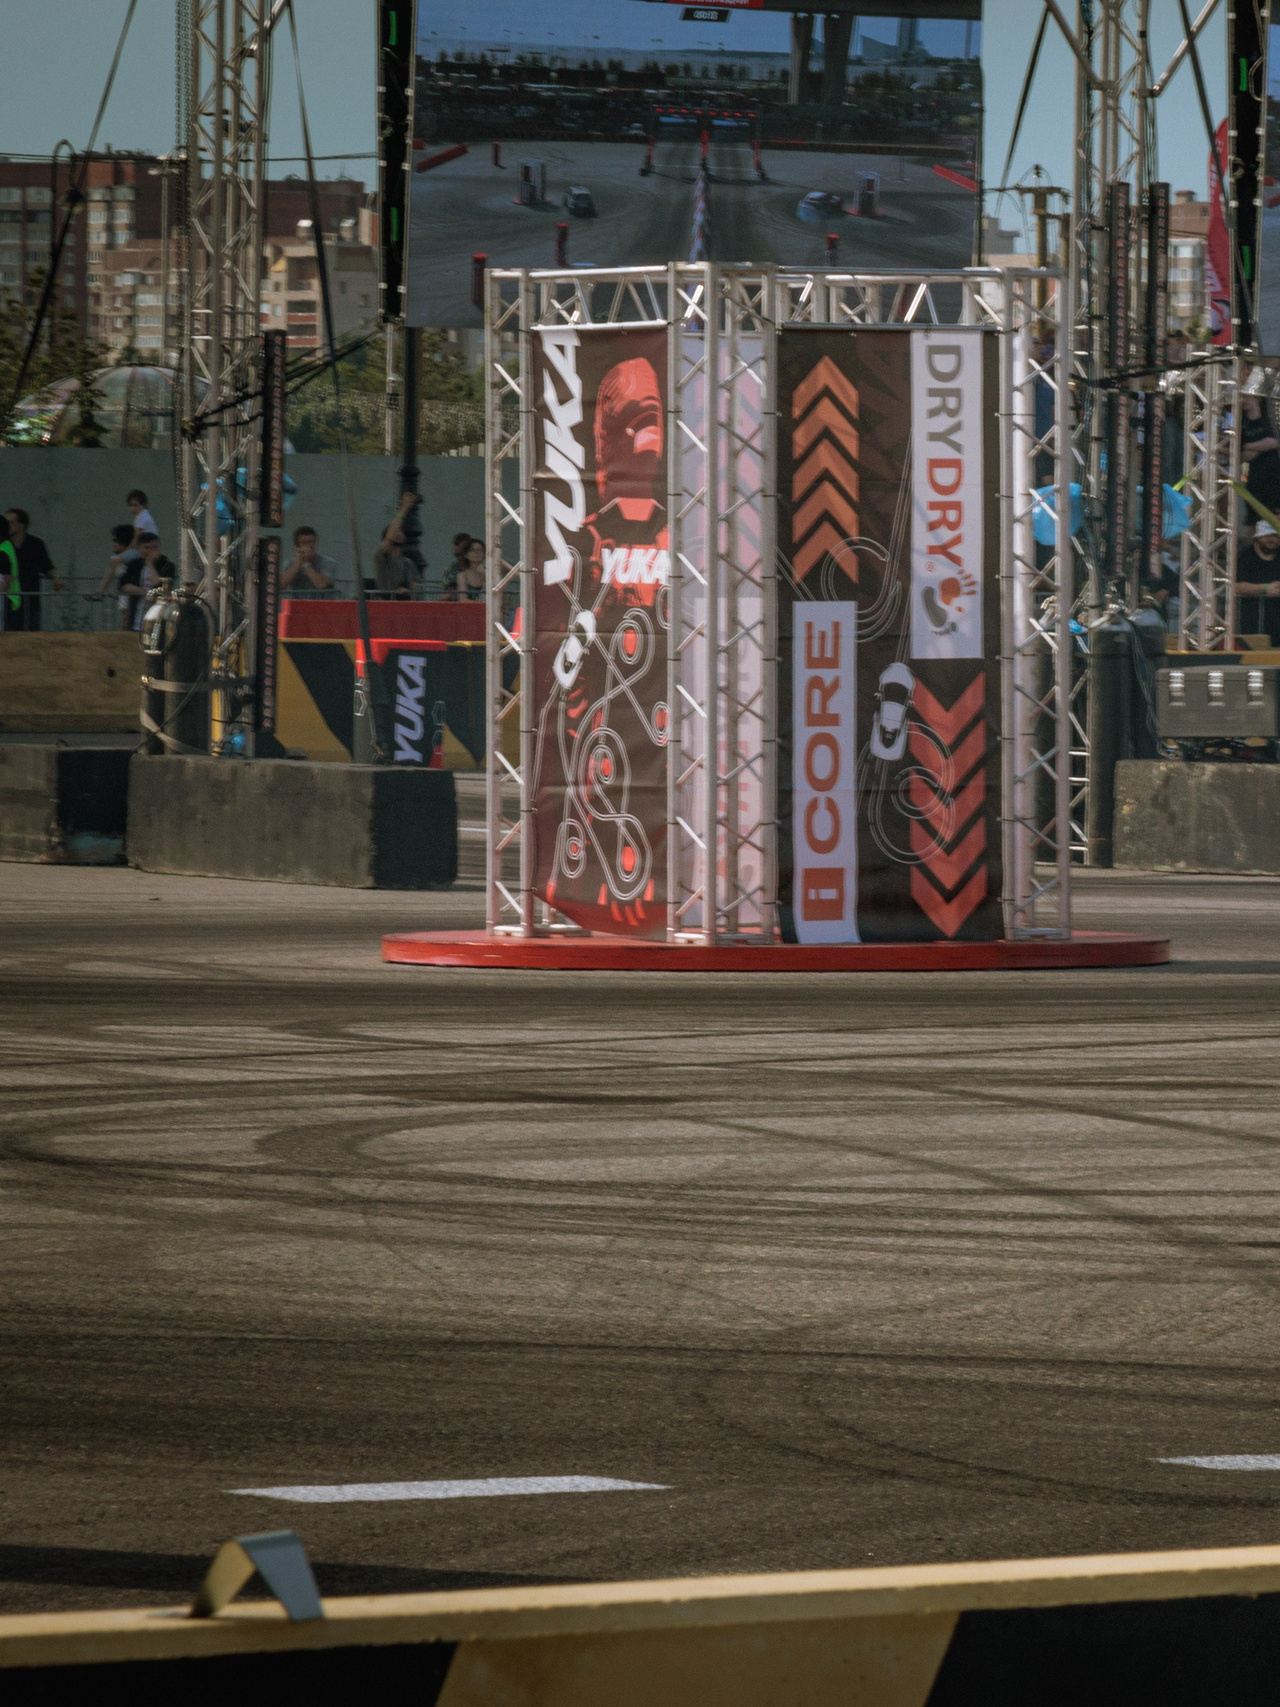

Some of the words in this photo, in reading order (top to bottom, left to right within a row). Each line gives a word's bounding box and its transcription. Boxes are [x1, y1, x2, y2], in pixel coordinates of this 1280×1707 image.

[541, 329, 586, 585] YUKA
[601, 547, 670, 585] YUKA
[394, 655, 427, 762] YUKA
[804, 621, 842, 854] CORE
